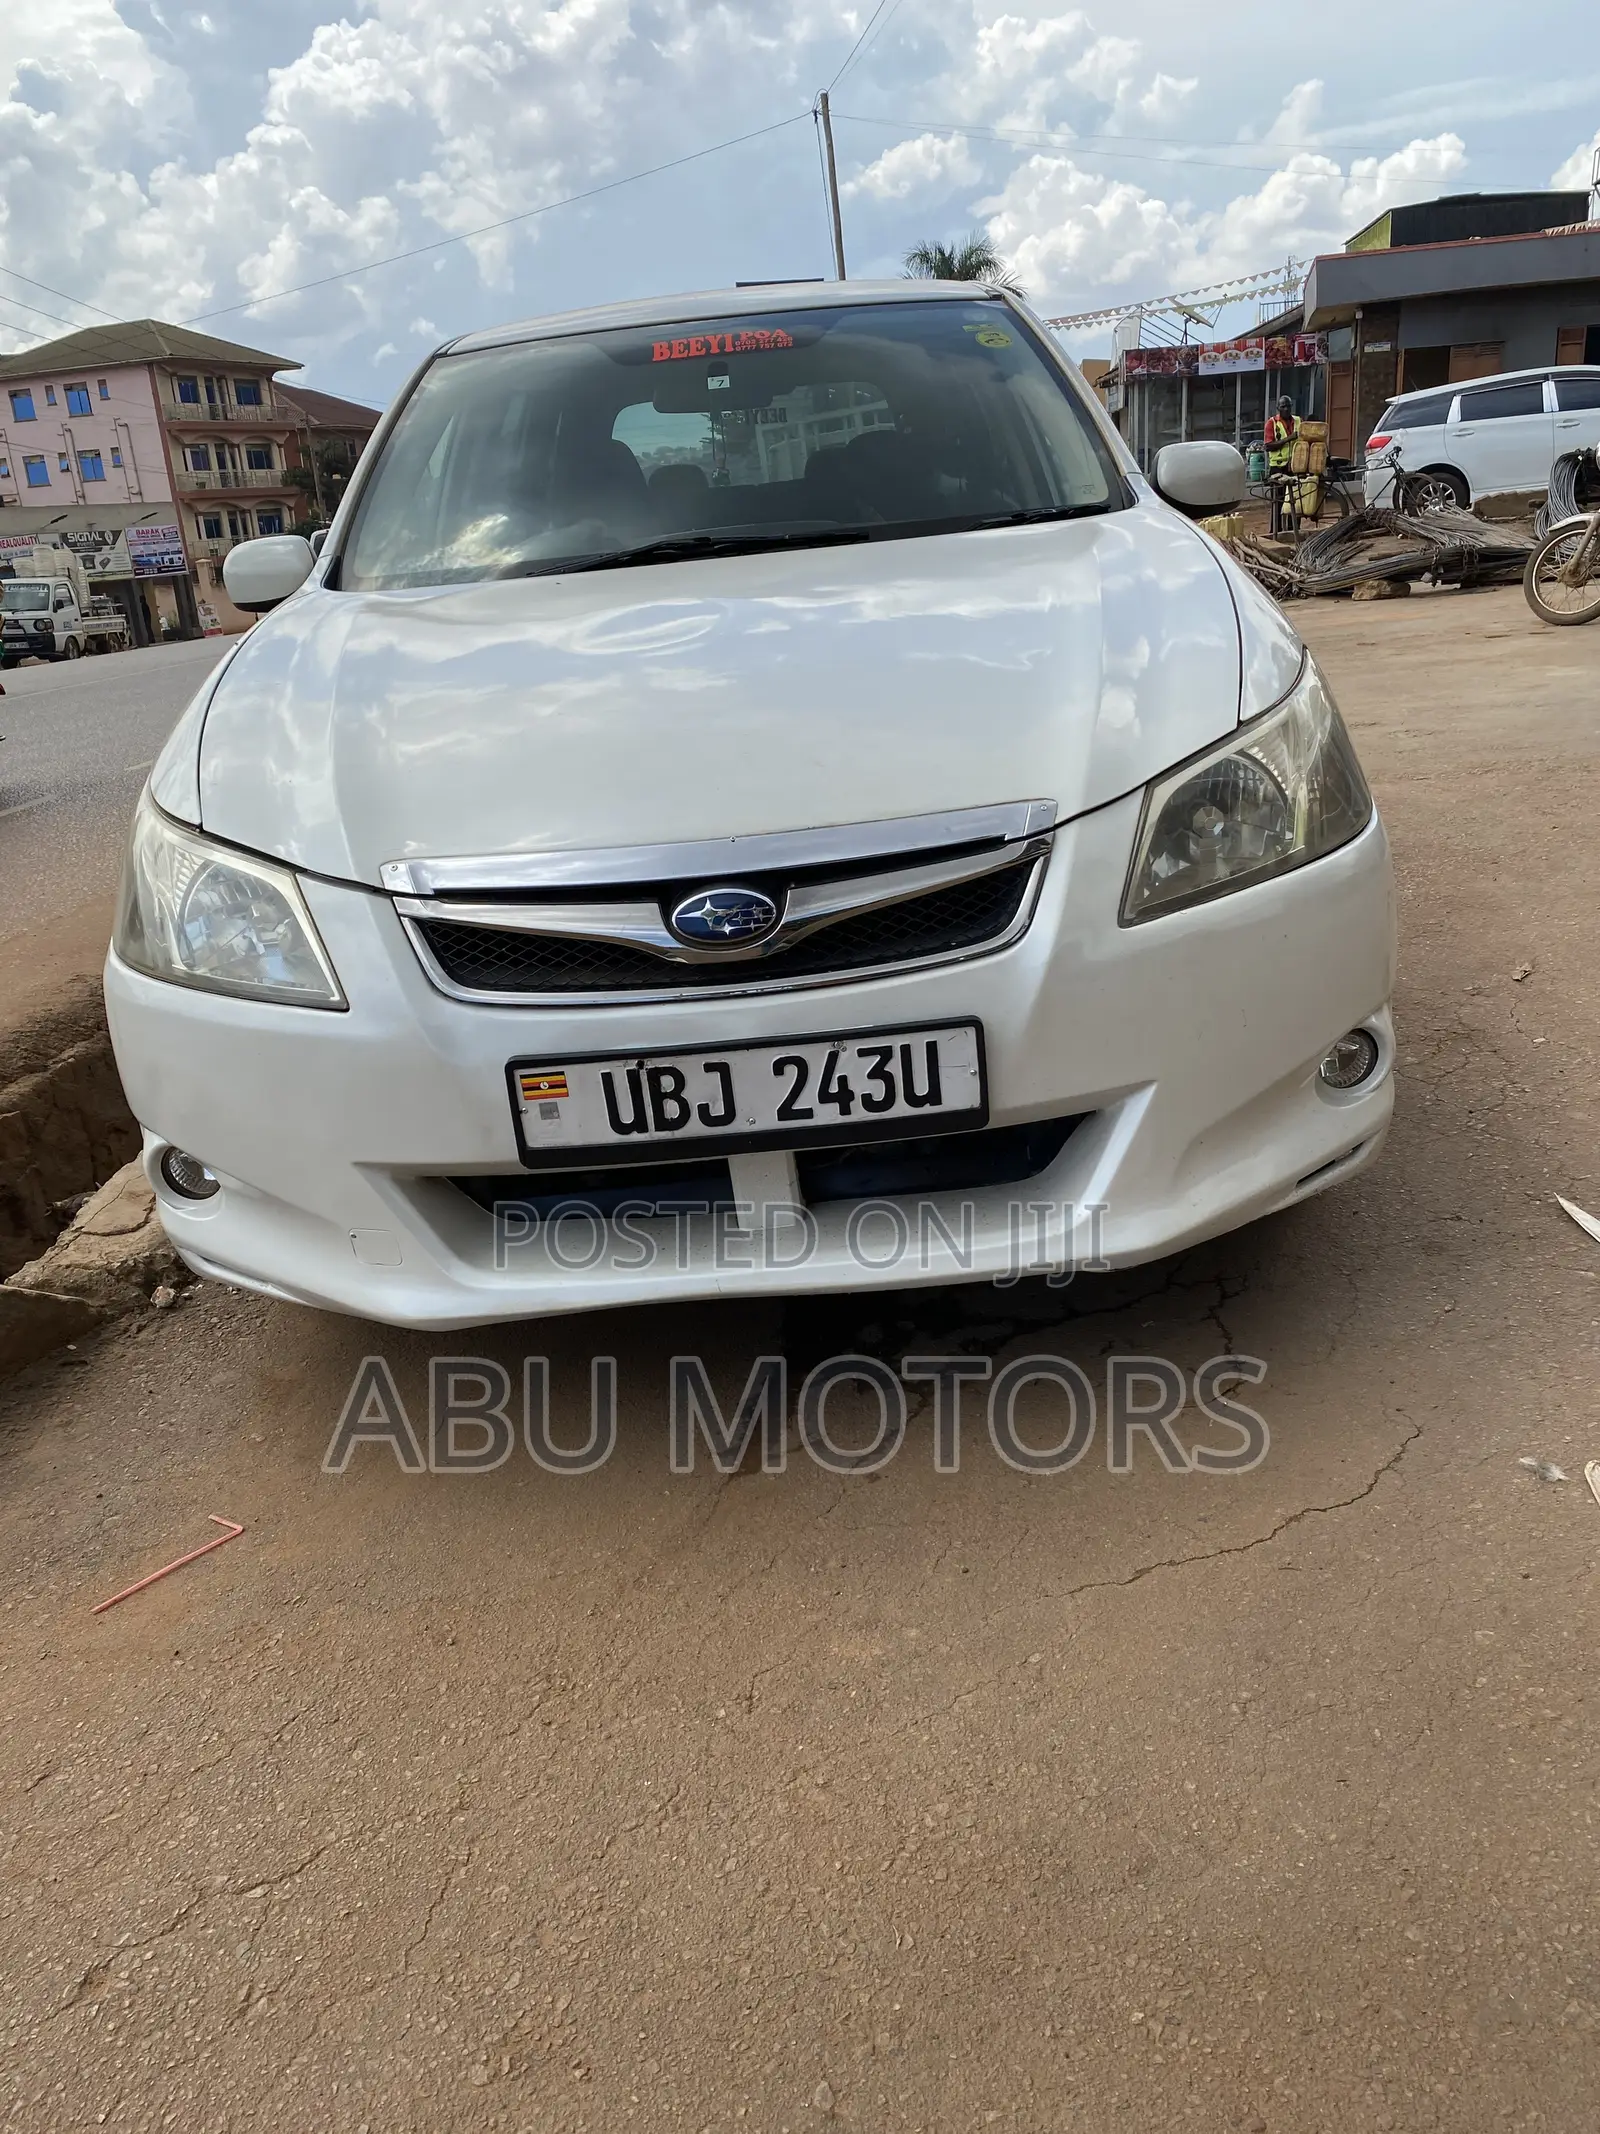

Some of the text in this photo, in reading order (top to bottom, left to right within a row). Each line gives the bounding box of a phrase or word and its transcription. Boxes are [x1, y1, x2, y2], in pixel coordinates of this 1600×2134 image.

[740, 328, 789, 341] POA
[652, 333, 735, 361] BEEYI
[67, 531, 102, 542] SIGNAL
[136, 528, 160, 536] BARAK
[600, 1040, 942, 1135] UBJ 243U
